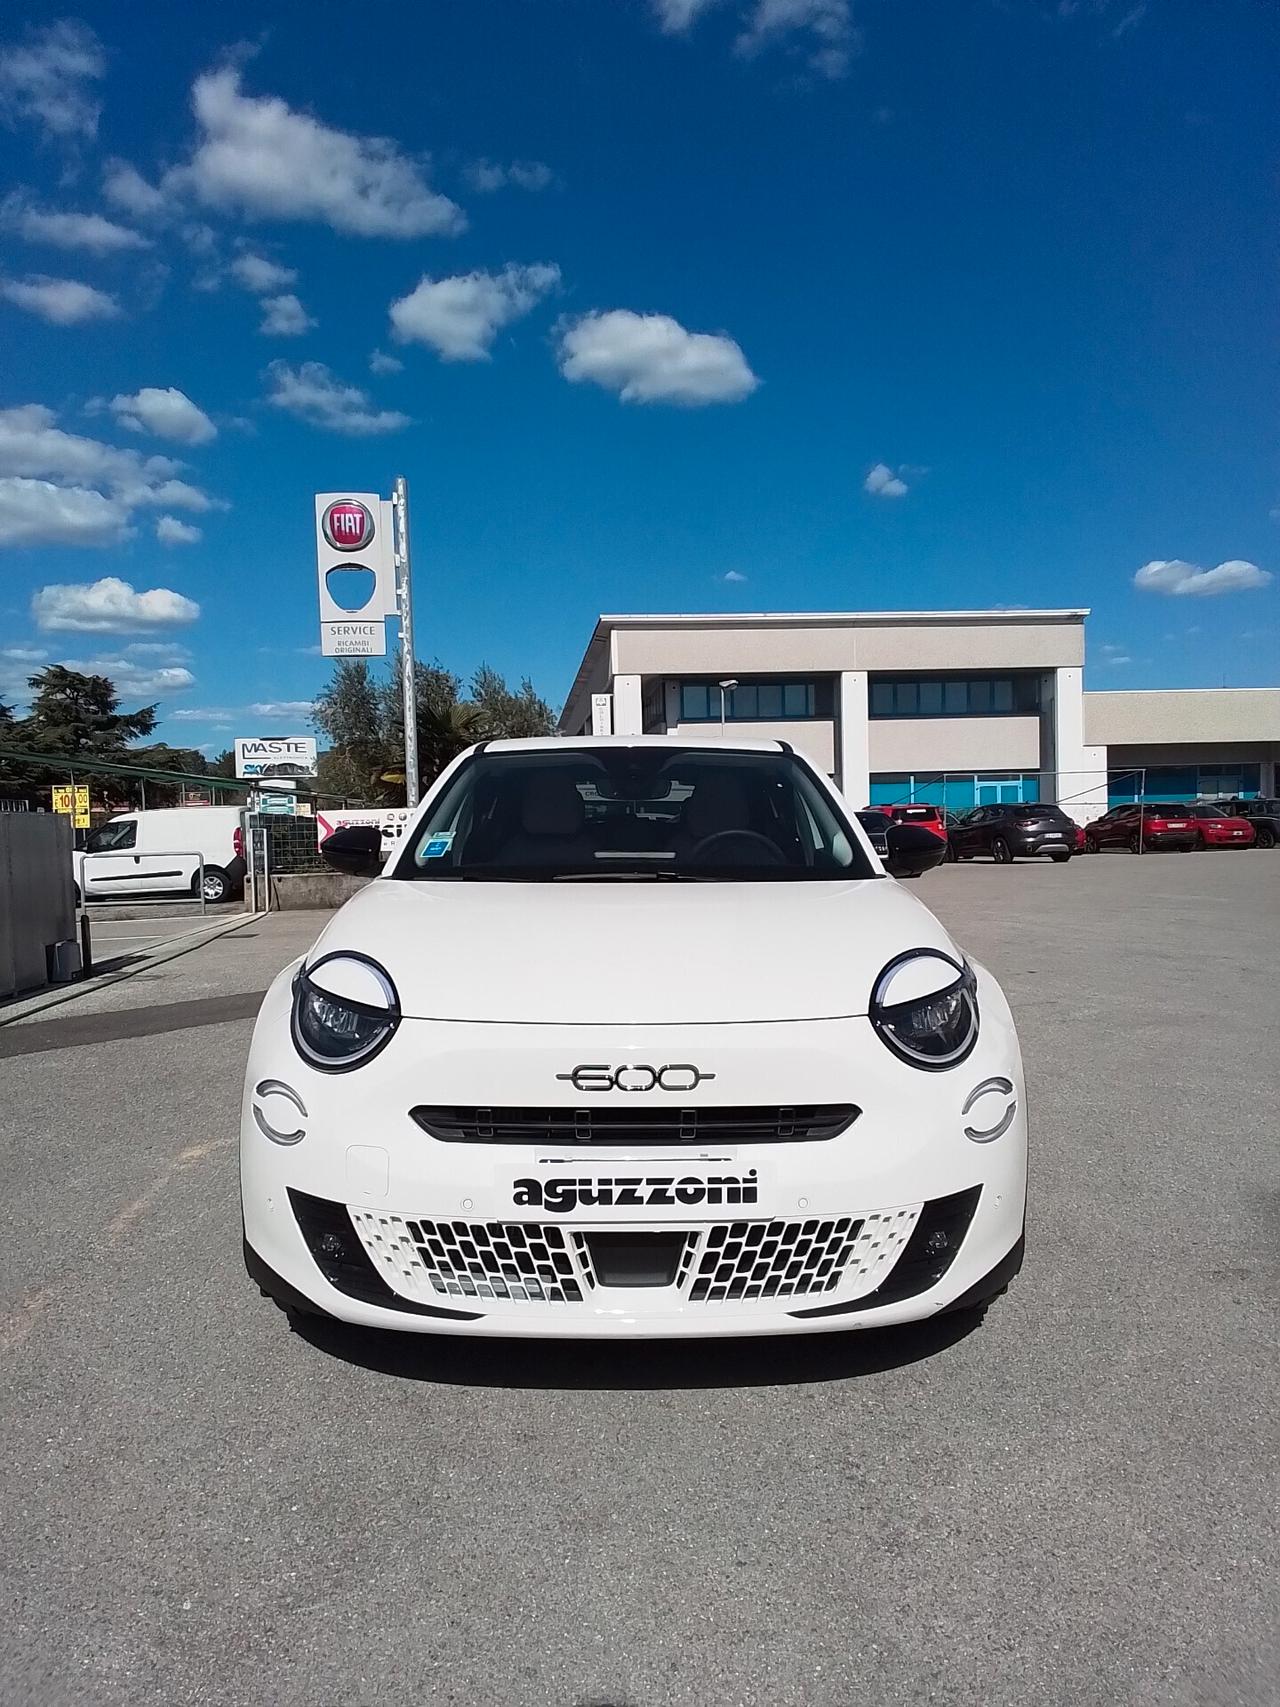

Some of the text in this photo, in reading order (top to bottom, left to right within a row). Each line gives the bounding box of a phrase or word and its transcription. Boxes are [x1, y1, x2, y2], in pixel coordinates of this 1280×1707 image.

[333, 513, 363, 535] FIAT
[330, 626, 375, 636] SERVICE
[570, 1064, 702, 1091] 600
[513, 1168, 758, 1213] aguzzoni
